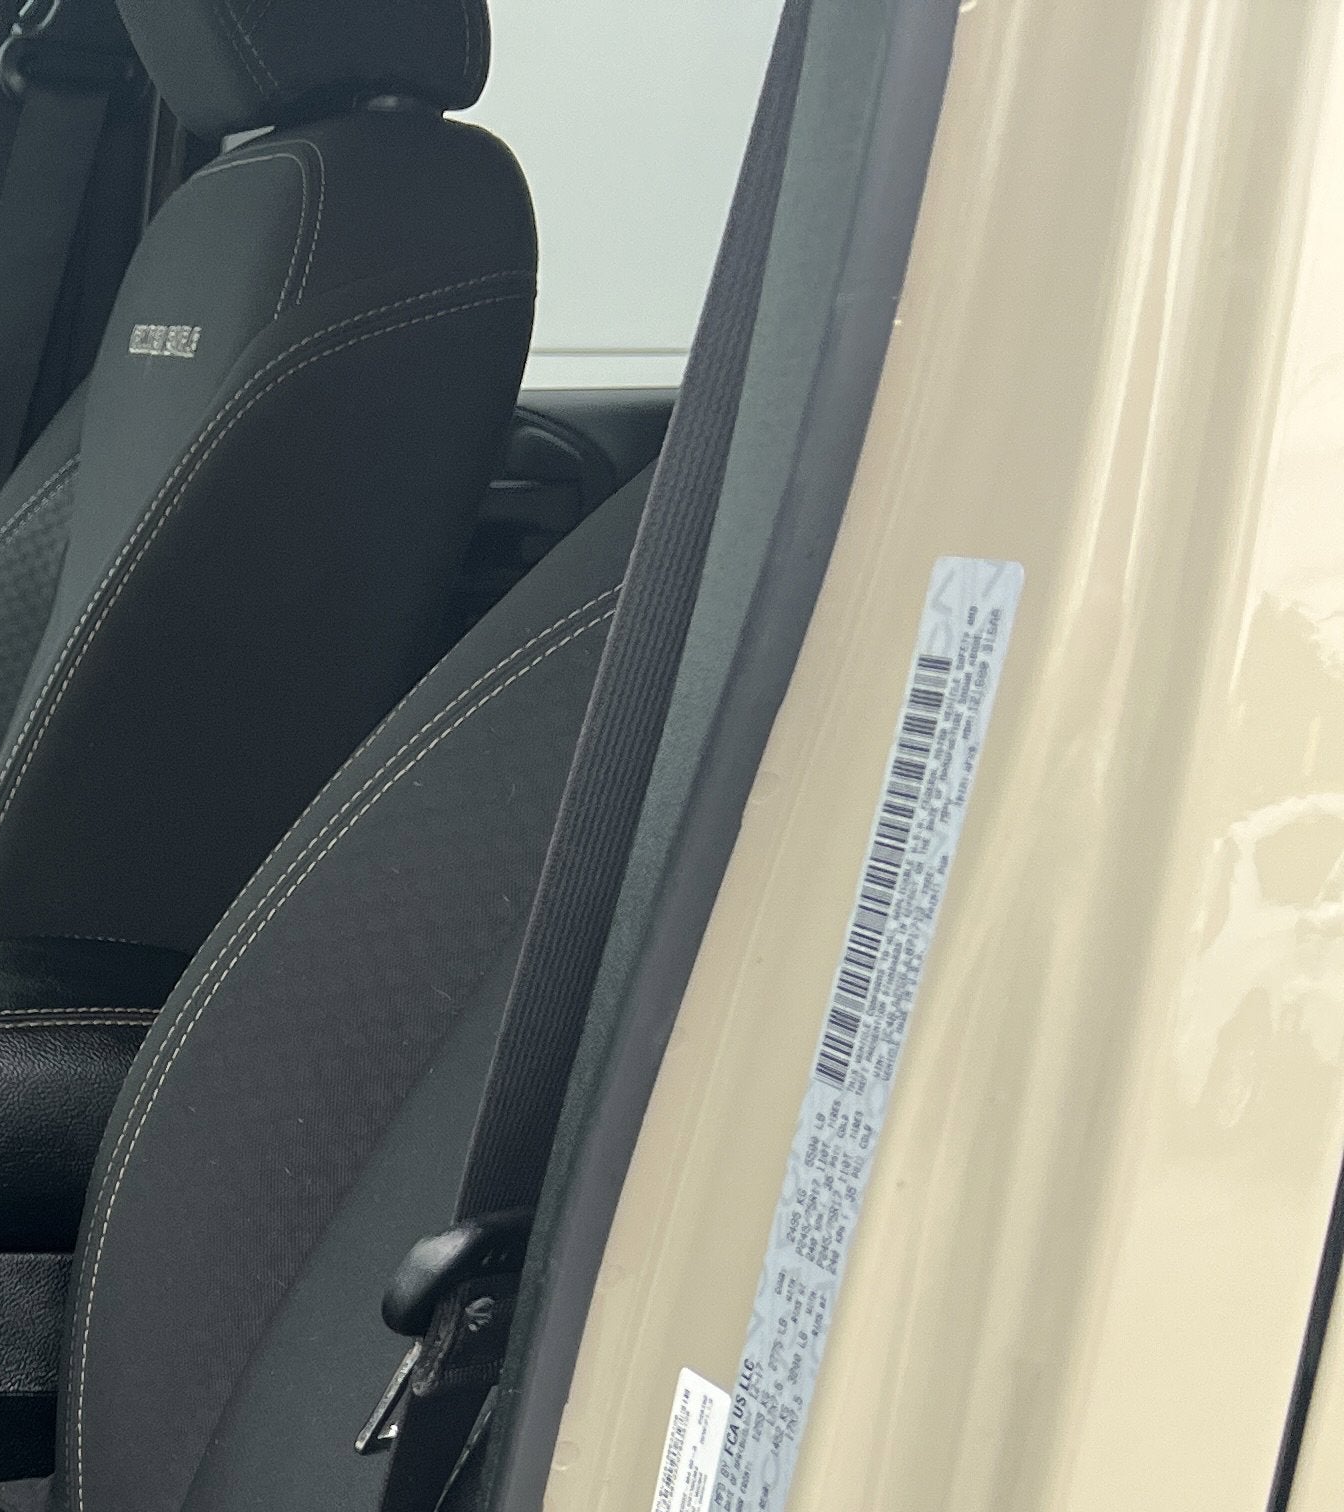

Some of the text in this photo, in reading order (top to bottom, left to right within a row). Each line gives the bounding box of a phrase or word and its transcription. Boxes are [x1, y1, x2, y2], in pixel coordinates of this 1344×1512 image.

[737, 1356, 755, 1392] LLC
[731, 1392, 746, 1420] US
[722, 1420, 740, 1457] FCA
